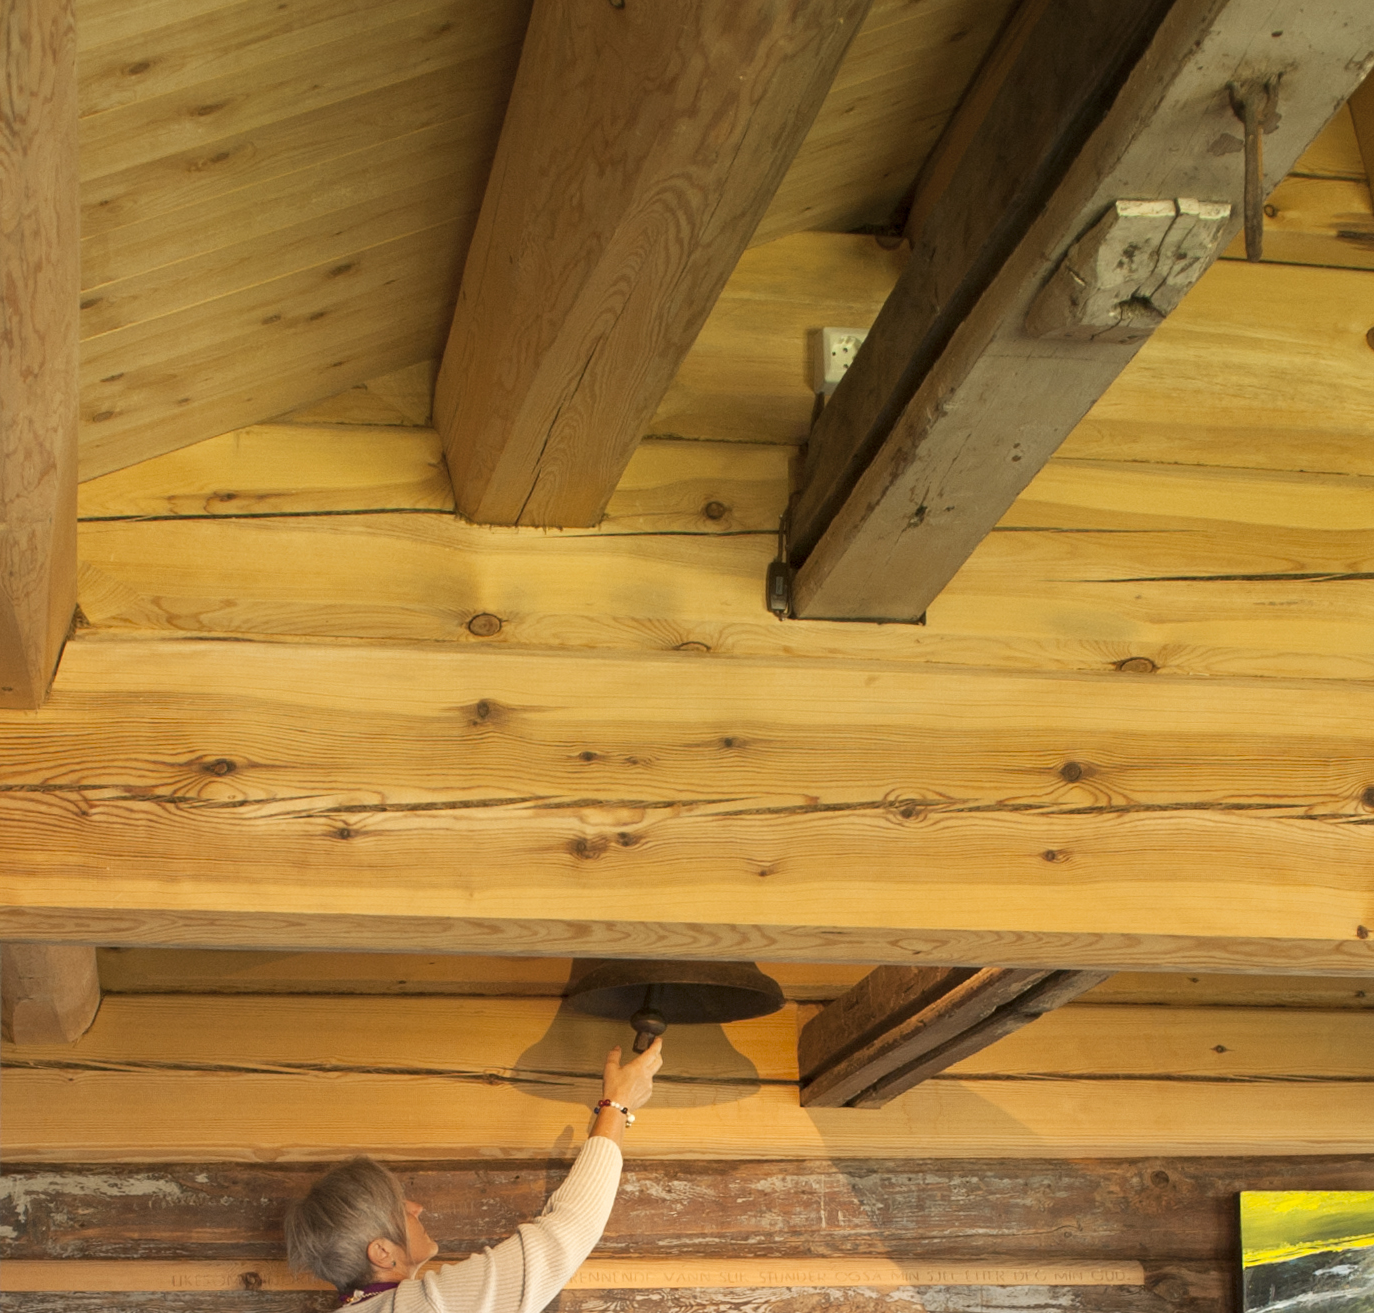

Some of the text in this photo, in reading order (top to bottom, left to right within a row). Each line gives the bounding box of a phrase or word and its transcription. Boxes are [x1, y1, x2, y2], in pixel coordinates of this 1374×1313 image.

[663, 1271, 712, 1284] VANN
[719, 1271, 750, 1284] SLIK
[759, 1271, 826, 1284] STUNDER
[891, 1270, 920, 1282] MIN
[926, 1269, 958, 1282] SJEL
[965, 1269, 1006, 1282] ETTER
[1013, 1270, 1047, 1282] DEG
[1054, 1271, 1083, 1281] MIN
[1091, 1270, 1131, 1282] GUD.
